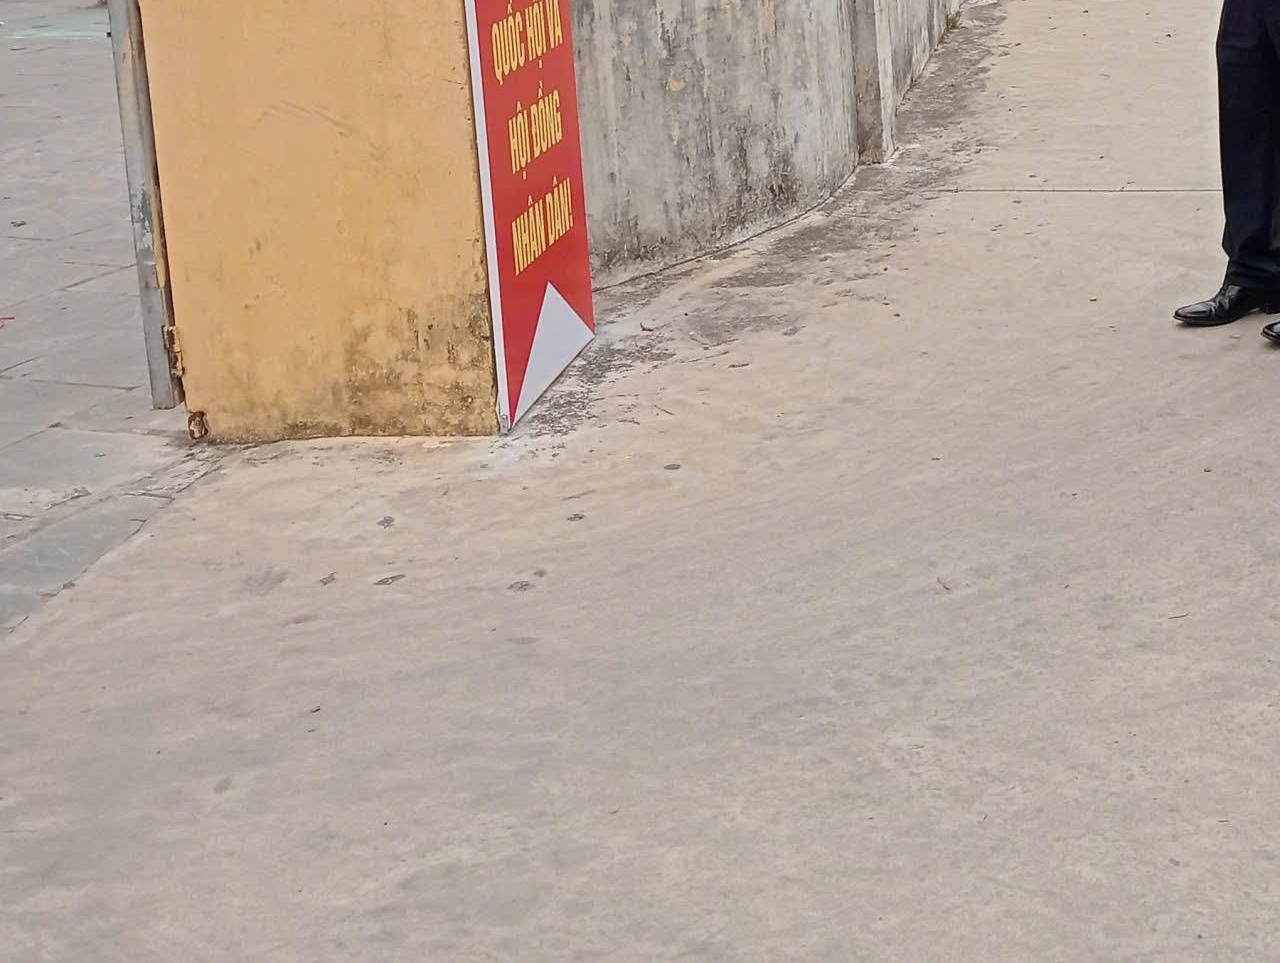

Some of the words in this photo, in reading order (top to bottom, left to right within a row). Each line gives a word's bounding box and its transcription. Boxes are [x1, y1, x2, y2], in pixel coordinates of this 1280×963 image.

[508, 101, 532, 180] HỘI
[530, 81, 563, 163] ĐỒNG
[511, 195, 547, 276] NHÂN
[545, 176, 574, 246] DÂN!
